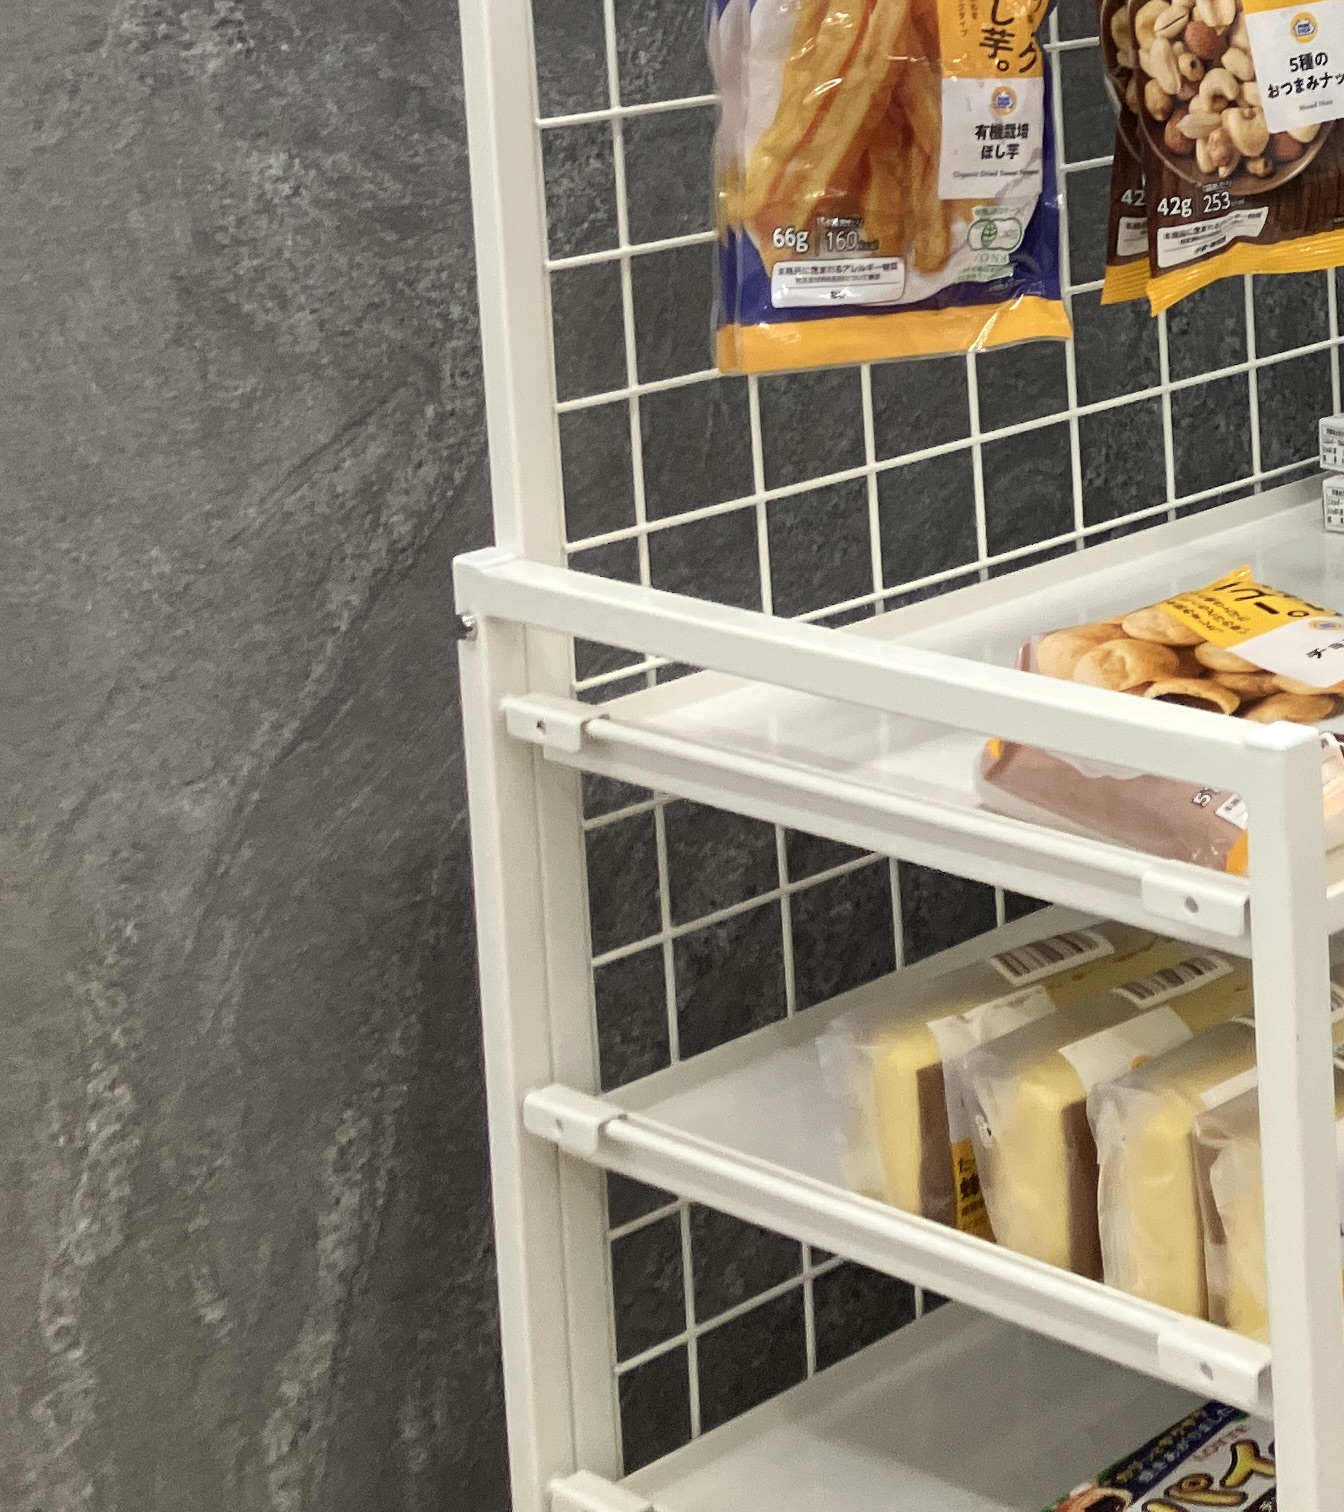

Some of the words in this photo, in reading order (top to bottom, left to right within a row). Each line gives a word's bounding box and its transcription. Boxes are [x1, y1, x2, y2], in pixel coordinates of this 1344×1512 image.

[1289, 51, 1329, 73] 5種の
[980, 143, 1020, 160] ほし芋
[1157, 196, 1192, 218] 42g
[772, 227, 809, 253] 66g
